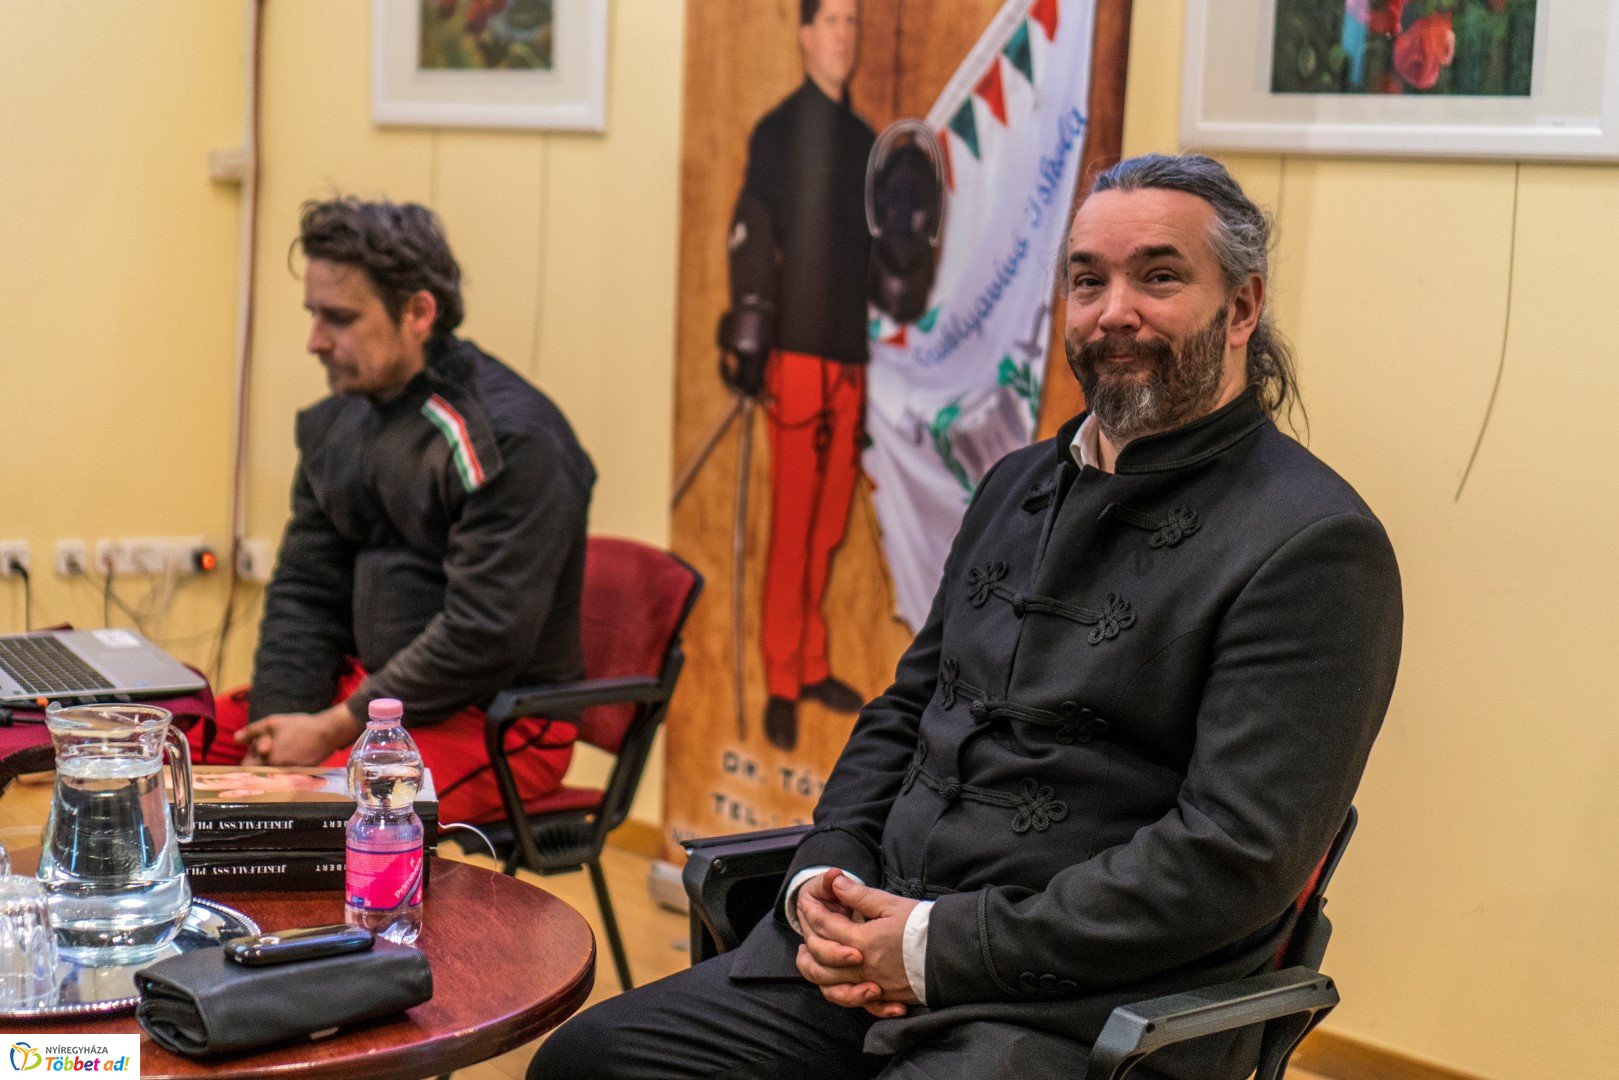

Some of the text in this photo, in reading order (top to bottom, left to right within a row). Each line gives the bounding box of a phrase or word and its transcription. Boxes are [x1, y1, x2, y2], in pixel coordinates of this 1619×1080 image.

[218, 820, 294, 830] JEKELFALUSSY
[322, 820, 349, 828] BERT
[211, 864, 287, 874] JEKELFALUSSY
[315, 863, 347, 872] BERT
